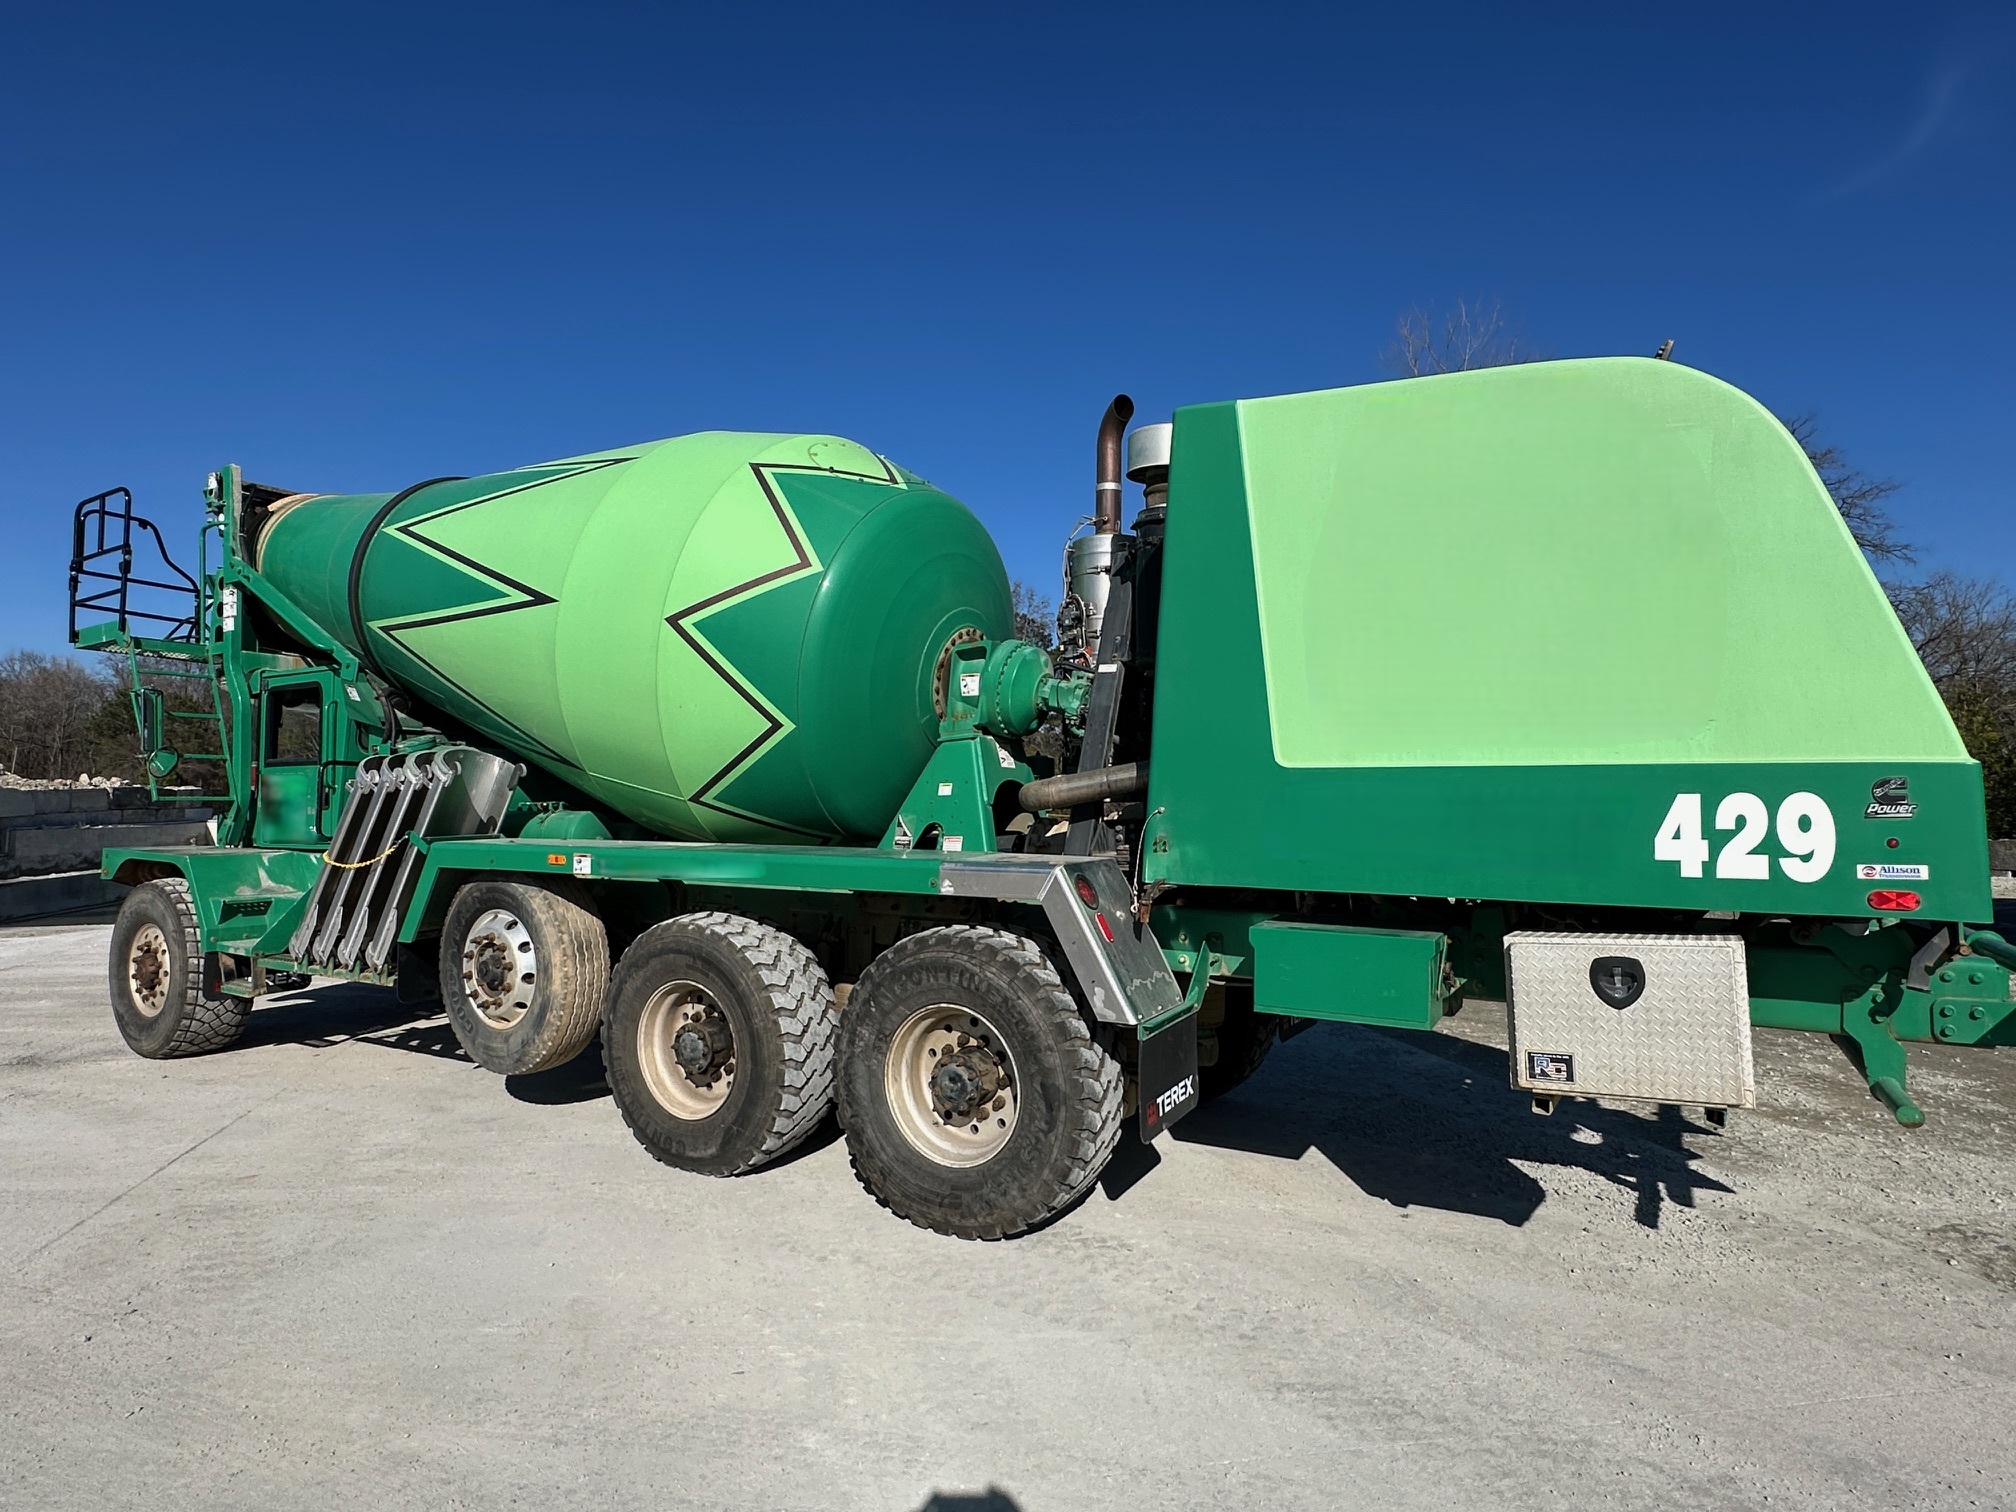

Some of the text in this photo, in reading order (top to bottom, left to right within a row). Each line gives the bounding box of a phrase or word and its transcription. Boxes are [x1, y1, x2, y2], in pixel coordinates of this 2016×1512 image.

[1866, 803, 1917, 814] Power
[1653, 791, 1837, 883] 429
[1878, 866, 1921, 874] Allison
[1156, 1074, 1194, 1117] TEREX
